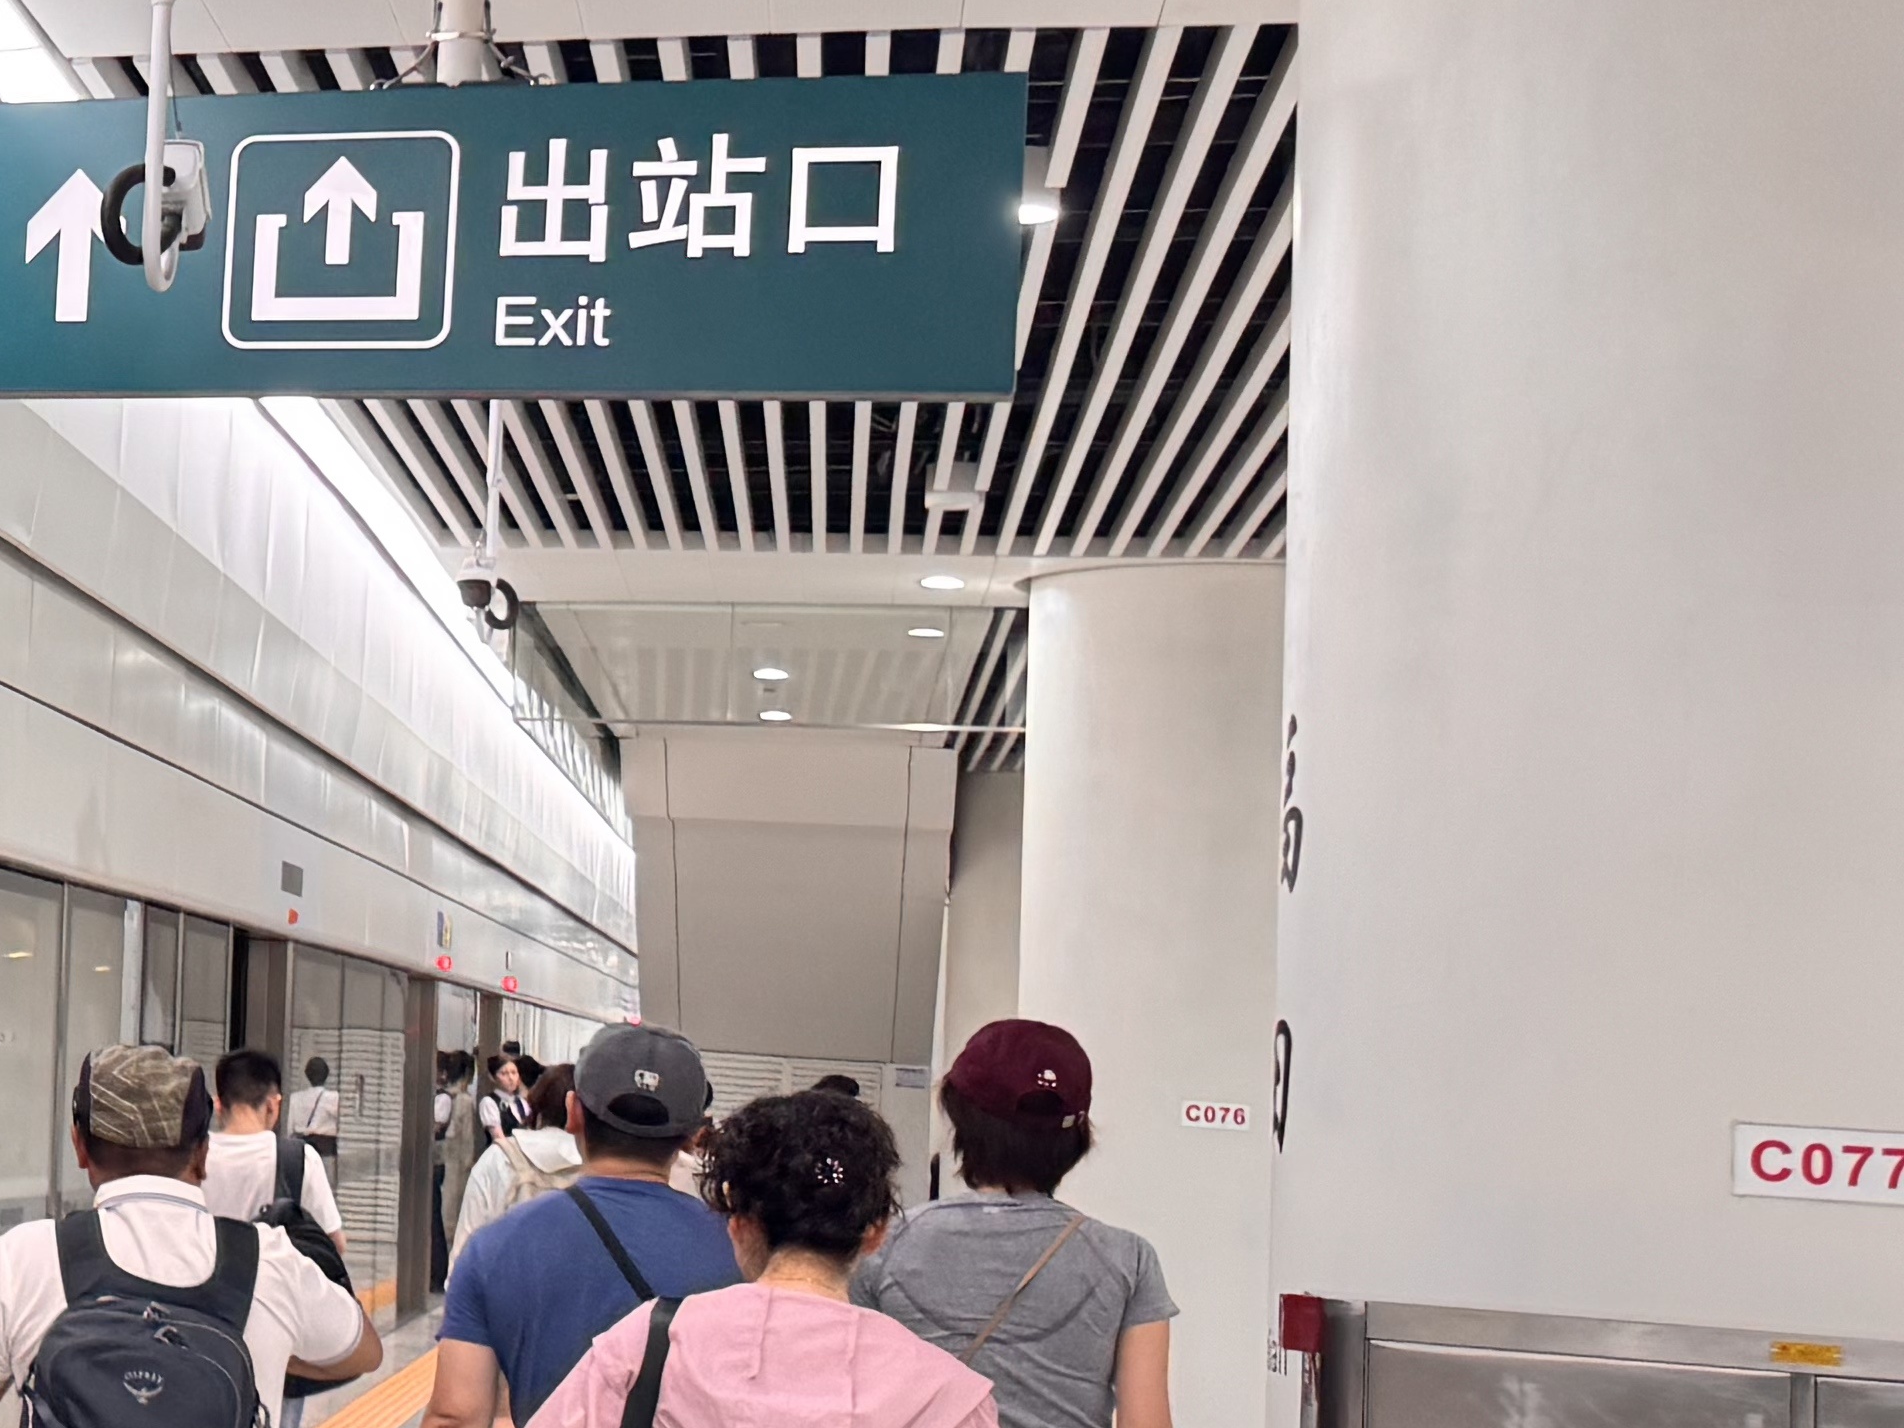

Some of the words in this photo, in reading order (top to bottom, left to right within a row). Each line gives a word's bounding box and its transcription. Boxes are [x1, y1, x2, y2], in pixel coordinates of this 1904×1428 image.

[499, 132, 900, 263] 出站口
[494, 294, 612, 349] Exit
[1185, 1104, 1246, 1126] C076
[1750, 1139, 1904, 1189] C077
